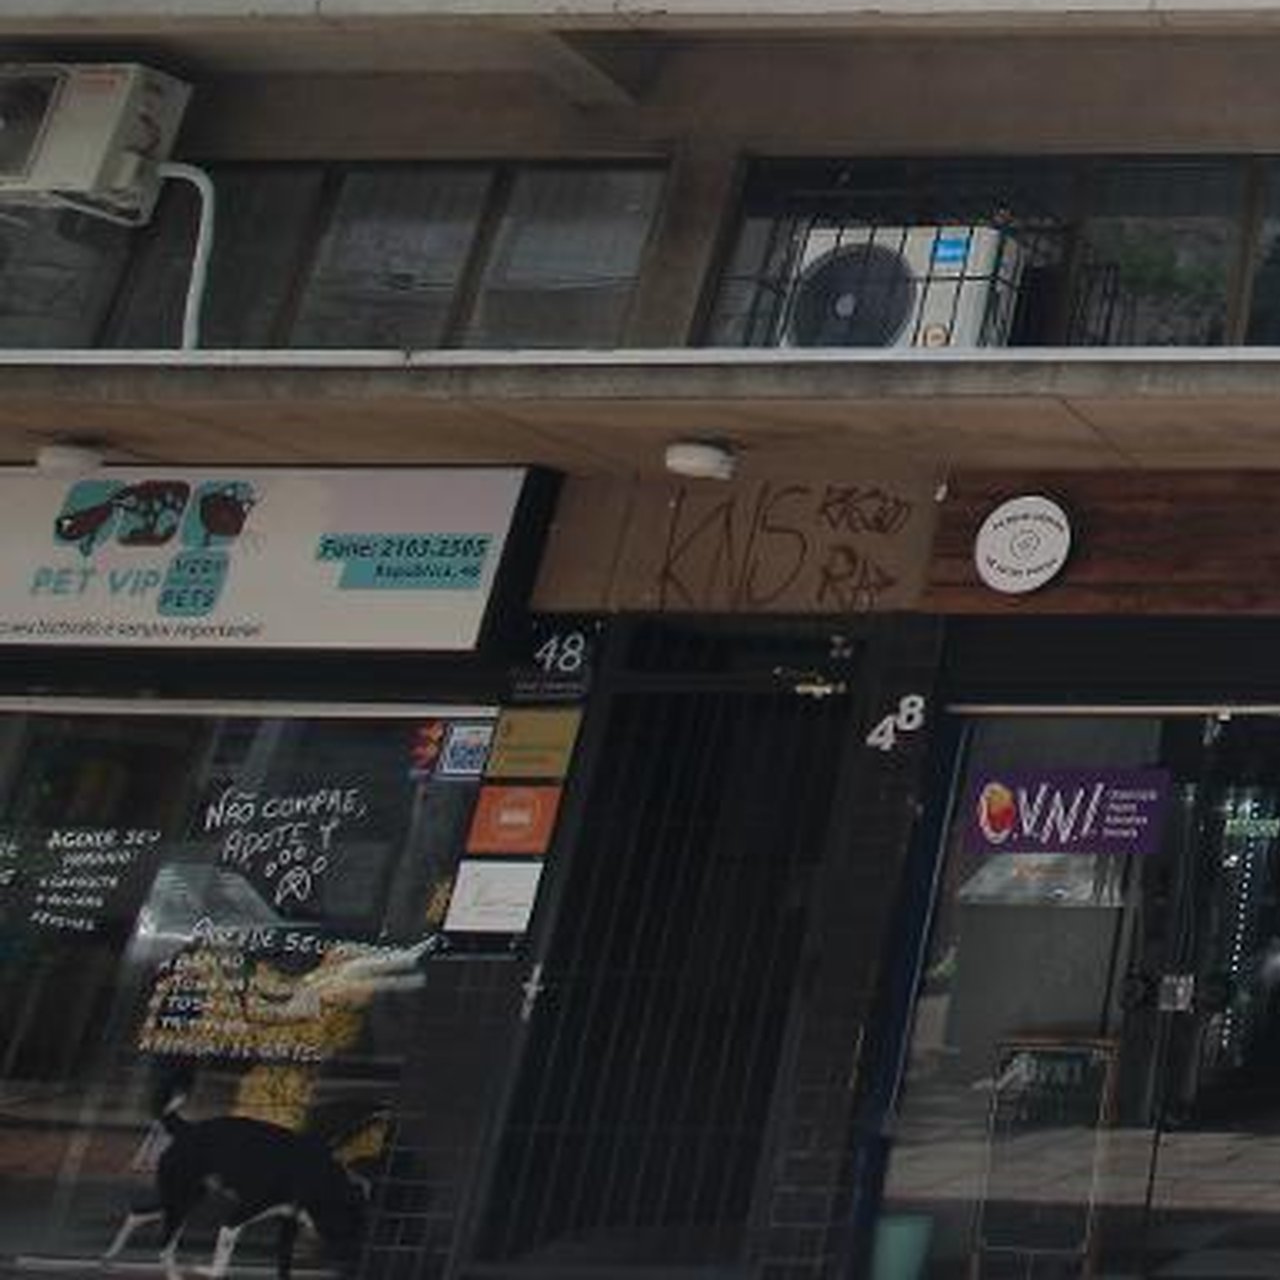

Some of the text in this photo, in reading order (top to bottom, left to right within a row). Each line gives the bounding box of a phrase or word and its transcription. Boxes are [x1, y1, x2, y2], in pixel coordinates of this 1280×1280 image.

[29, 568, 163, 597] PET VIP
[533, 630, 586, 671] 48
[866, 694, 925, 752] 48
[204, 786, 256, 831] NÃO
[222, 821, 310, 863] ADOTE
